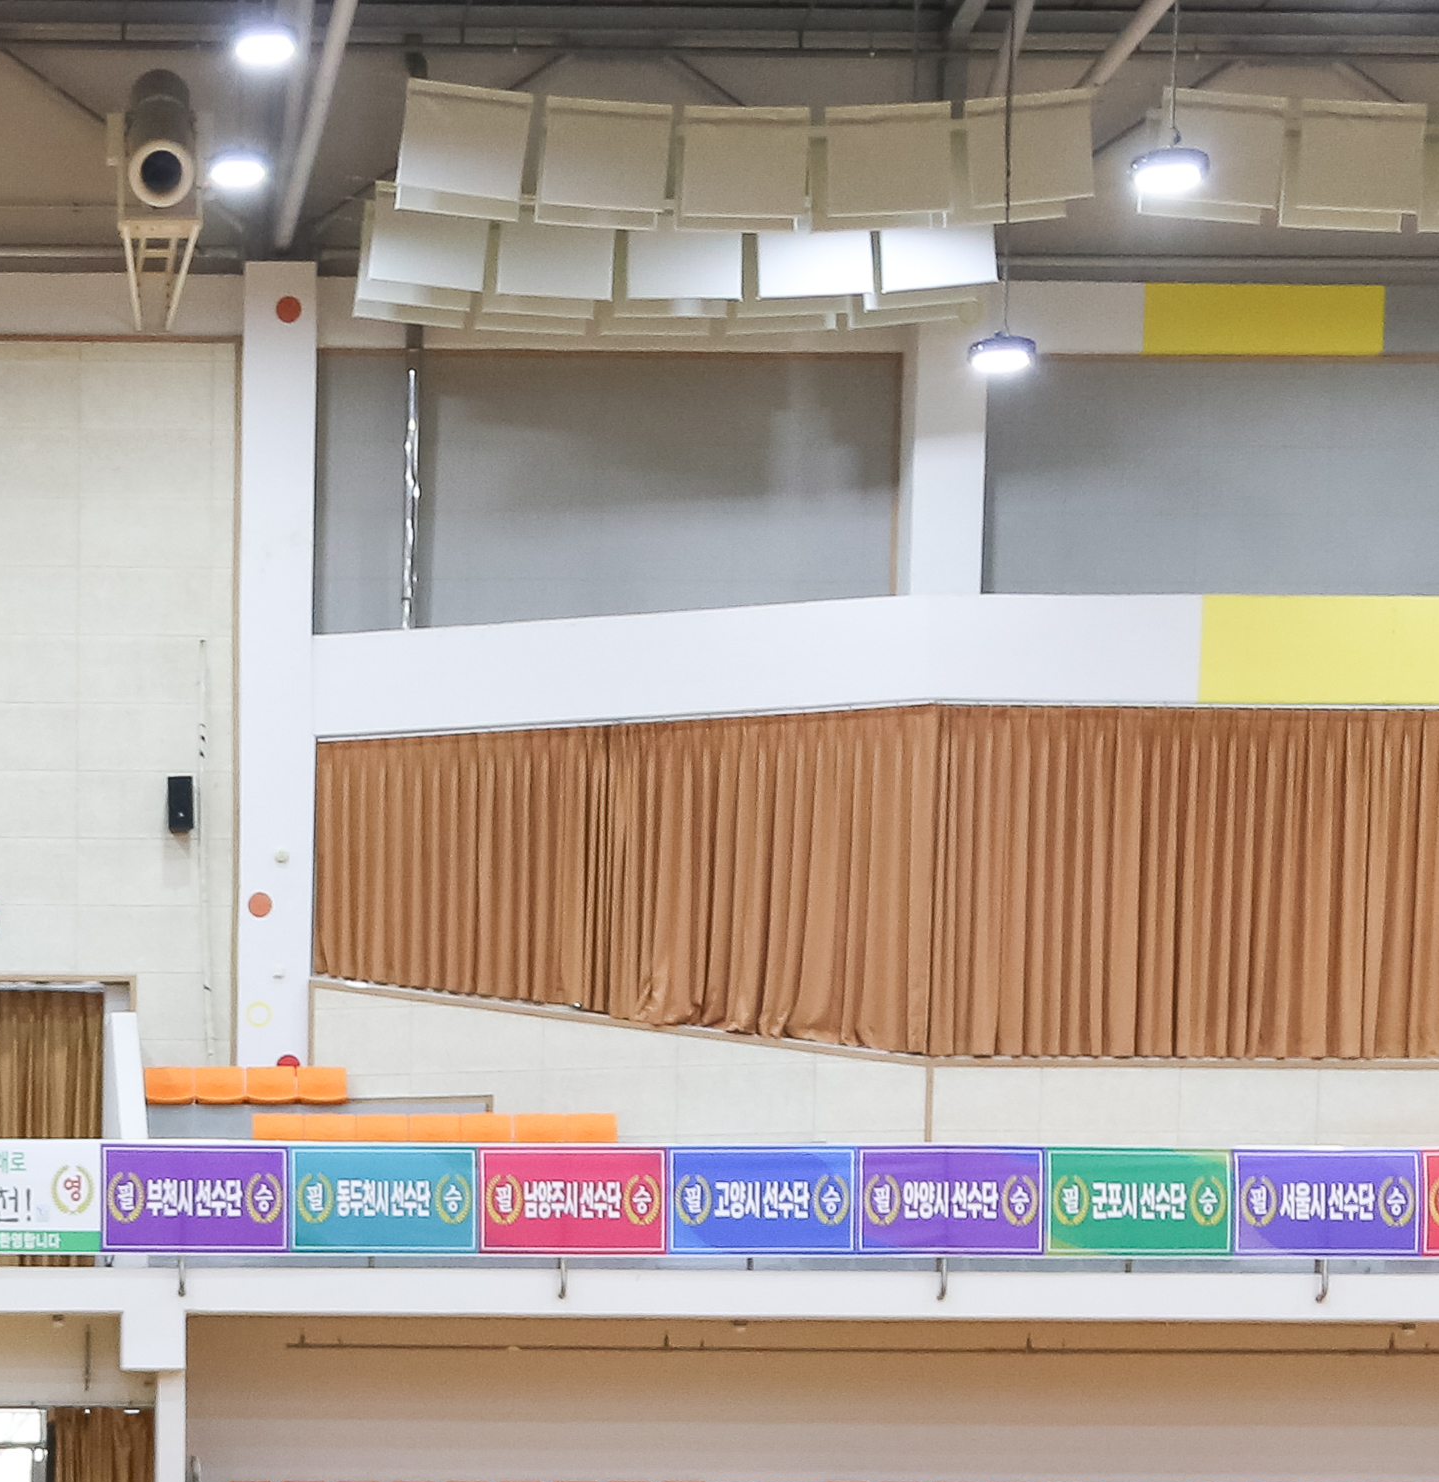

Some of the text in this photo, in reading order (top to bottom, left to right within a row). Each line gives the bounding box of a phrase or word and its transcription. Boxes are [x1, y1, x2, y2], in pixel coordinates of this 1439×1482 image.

[63, 1174, 82, 1202] 영
[117, 1178, 274, 1217] 필 부천시 선수단 승
[306, 1179, 464, 1217] 필 동두천시 선수단 승
[495, 1180, 652, 1219] 필 남양주시 선수단 승
[684, 1180, 842, 1219] 필 고양시 선수단 승
[873, 1181, 1030, 1220] 필 안양시 선수단 승
[1062, 1182, 1218, 1220] 필 군포시 선수단 승
[1249, 1182, 1406, 1221] 필 서울시 선수단 승
